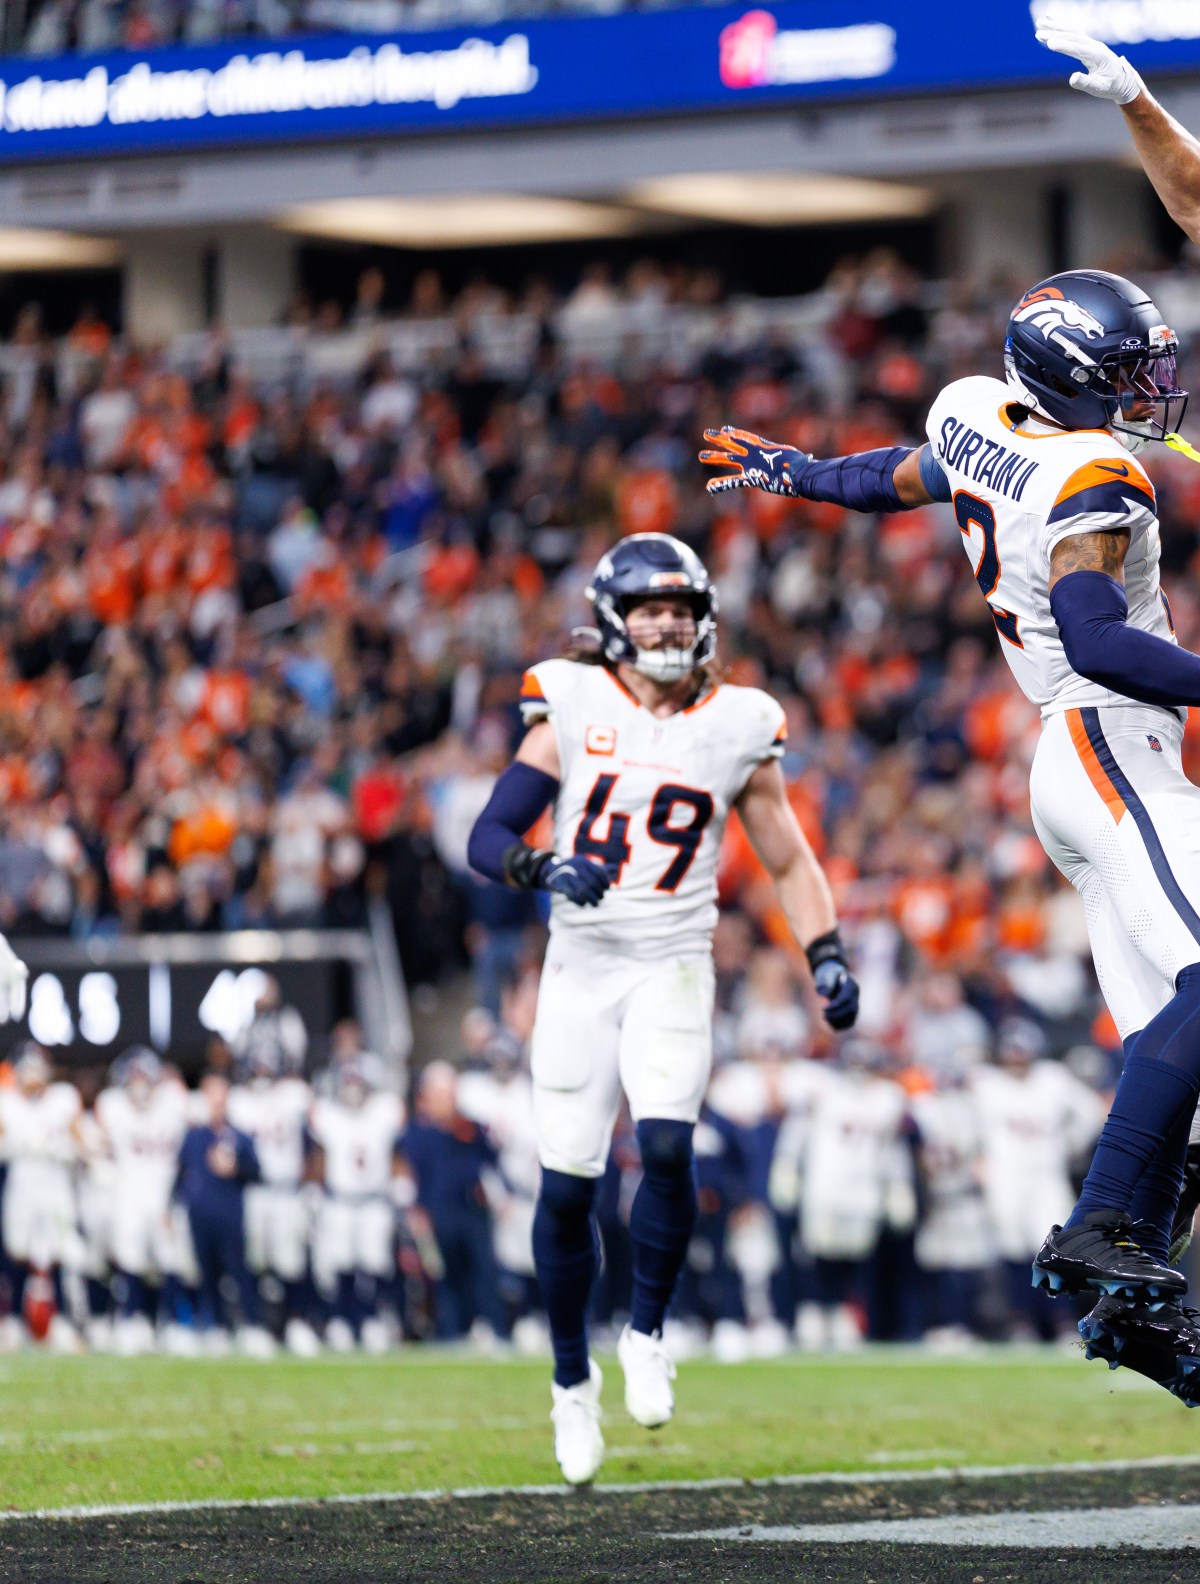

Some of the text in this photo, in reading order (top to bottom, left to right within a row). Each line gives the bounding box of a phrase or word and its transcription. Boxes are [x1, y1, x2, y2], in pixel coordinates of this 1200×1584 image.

[938, 416, 1040, 502] SURTAIN II
[952, 489, 1024, 649] 2
[573, 773, 714, 893] 49
